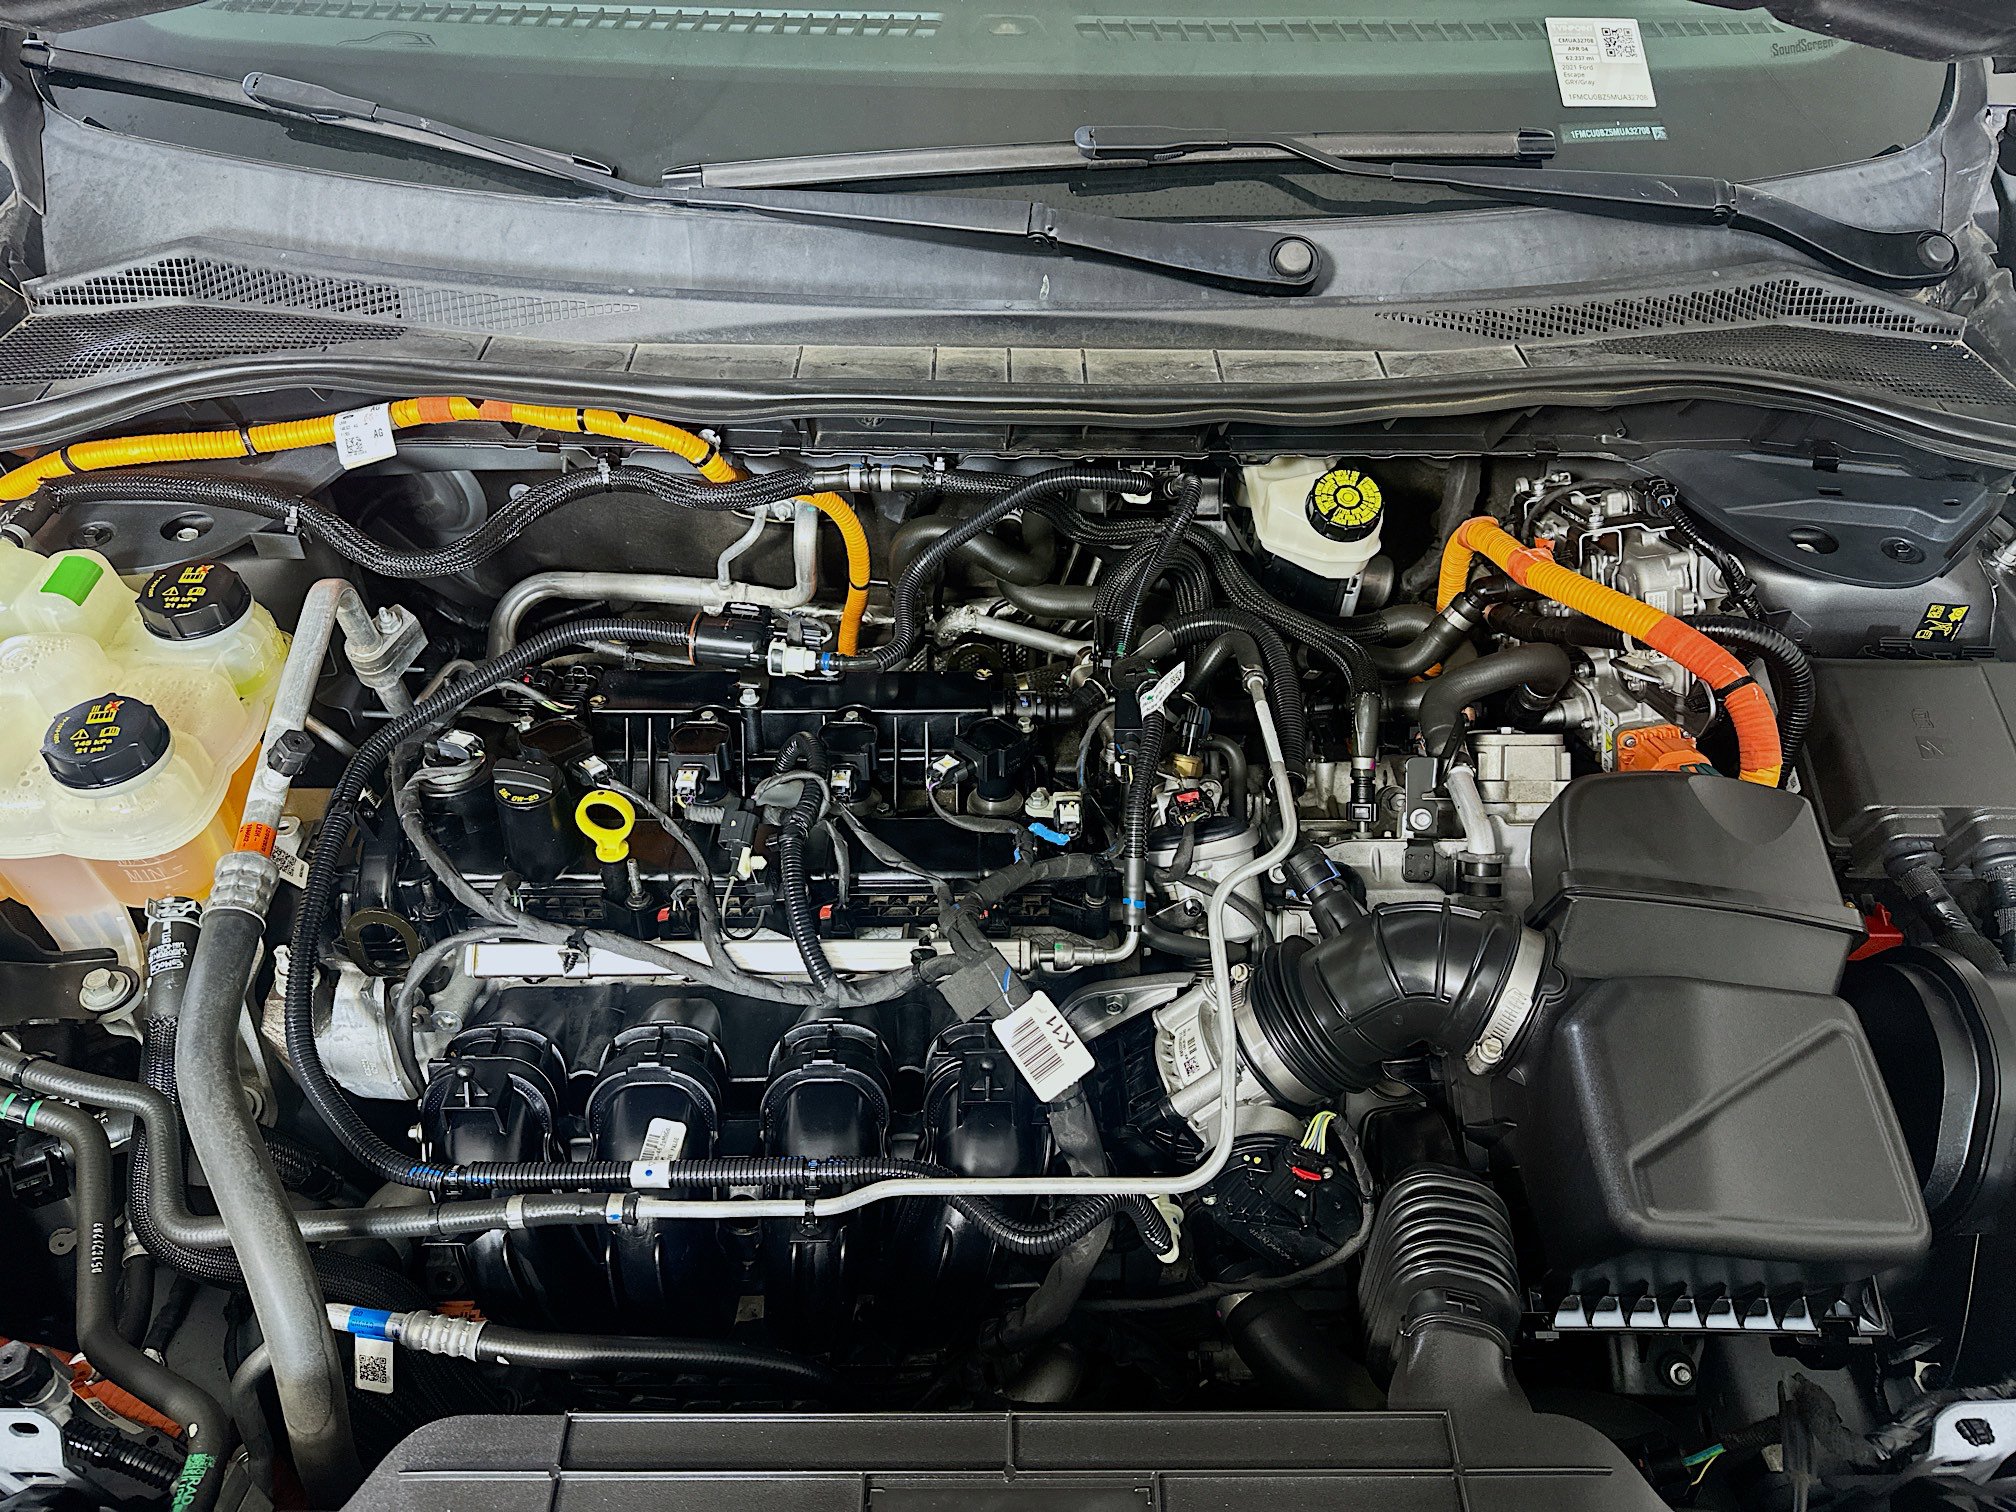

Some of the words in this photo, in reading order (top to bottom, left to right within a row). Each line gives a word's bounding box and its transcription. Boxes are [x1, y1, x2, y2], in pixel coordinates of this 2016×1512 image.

[373, 427, 384, 439] AG
[123, 867, 166, 881] MIN
[1045, 1015, 1075, 1050] K11
